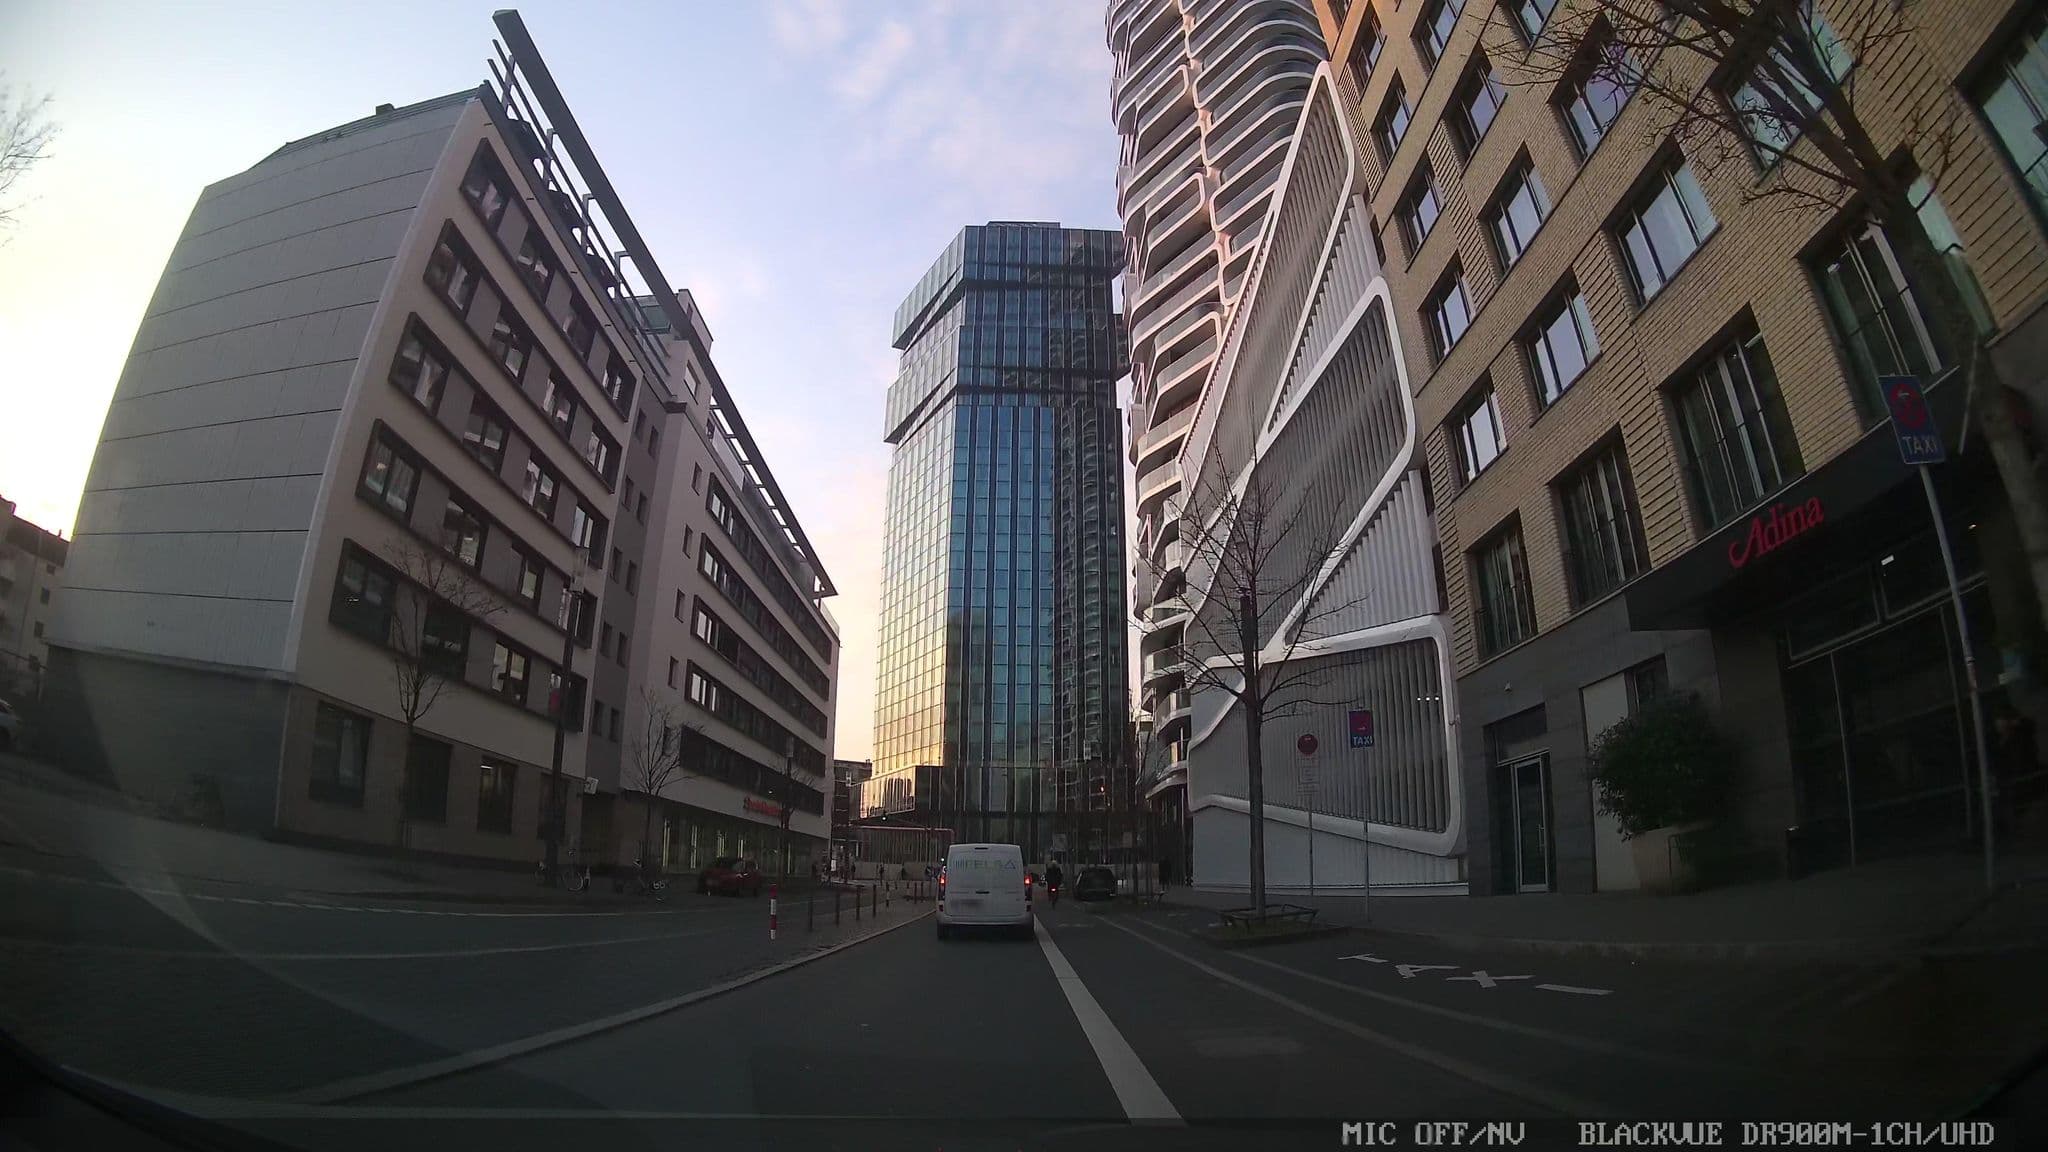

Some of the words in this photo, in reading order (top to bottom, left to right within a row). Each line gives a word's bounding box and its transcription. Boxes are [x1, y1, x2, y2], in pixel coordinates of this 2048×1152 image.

[1903, 437, 1940, 455] TAXI
[1728, 496, 1825, 569] Adina
[1352, 736, 1374, 746] TAXI
[1337, 953, 1614, 996] TAXI
